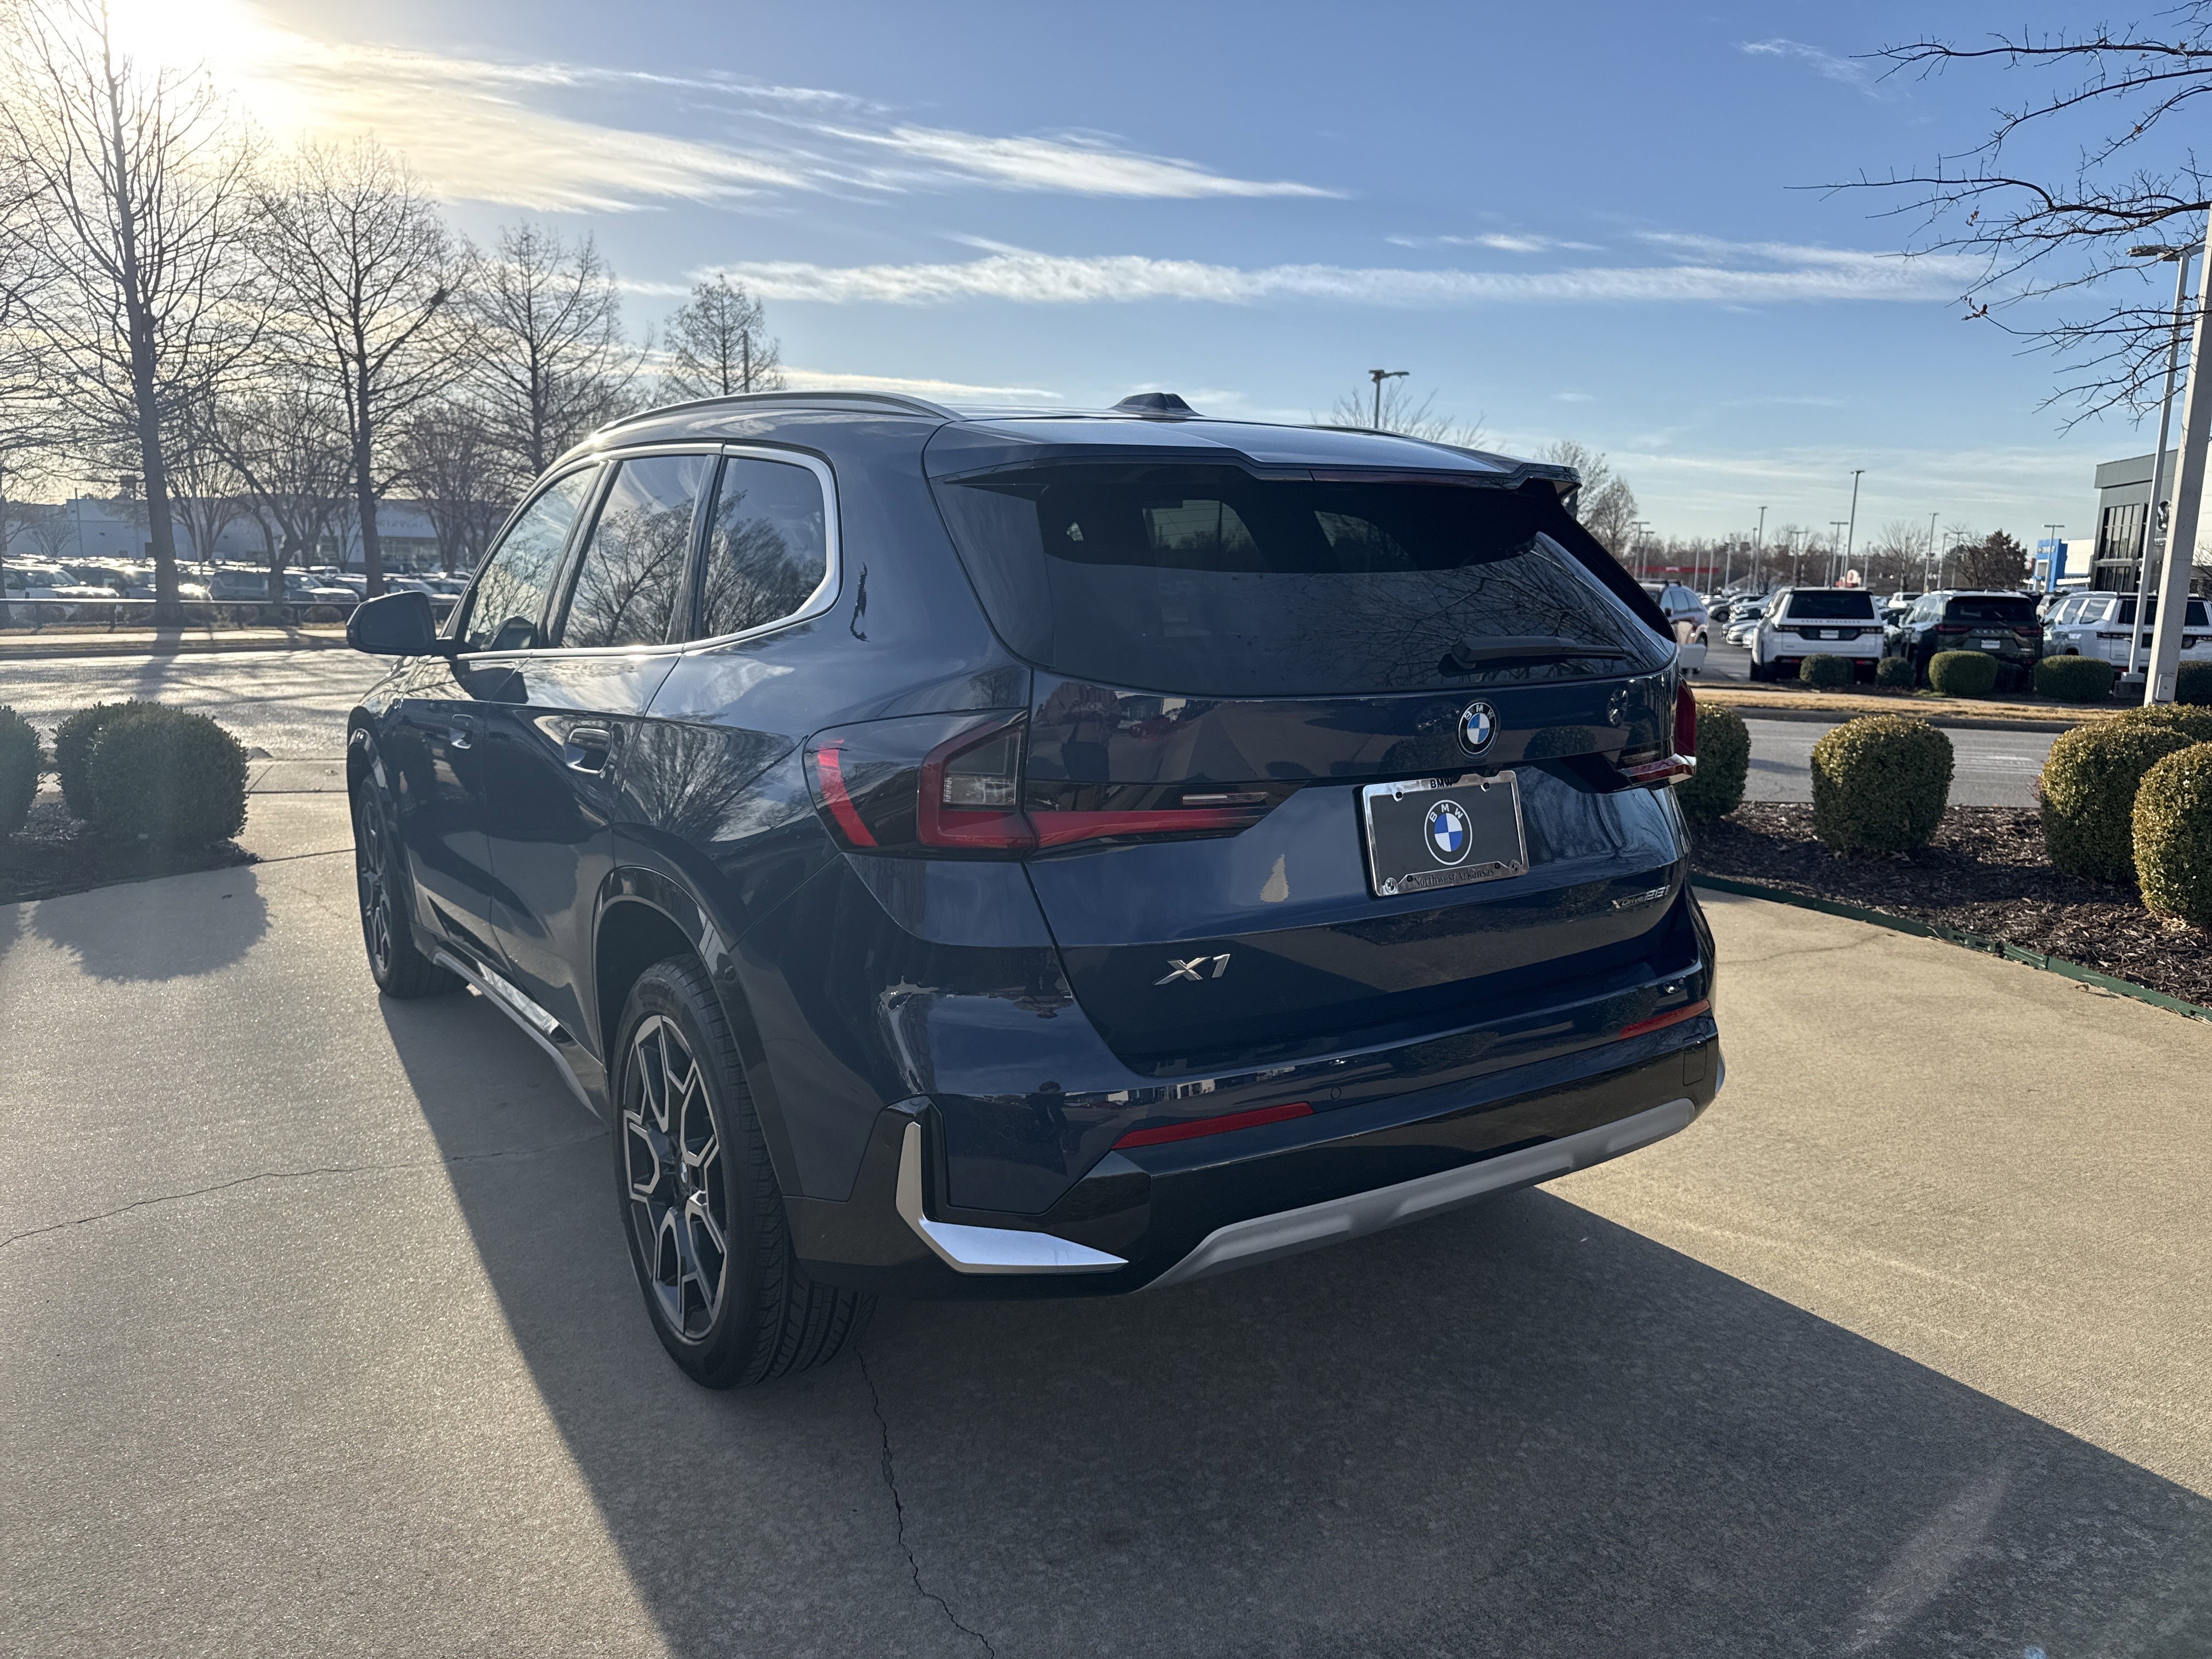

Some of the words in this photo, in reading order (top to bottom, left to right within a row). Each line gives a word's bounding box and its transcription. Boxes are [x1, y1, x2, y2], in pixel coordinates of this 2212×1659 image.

[1464, 704, 1494, 721] BMW
[1430, 778, 1453, 788] BMW
[1429, 803, 1464, 823] BMW
[1414, 873, 1455, 887] Northwest
[1458, 868, 1494, 881] Arkansas
[1154, 953, 1231, 986] X1
